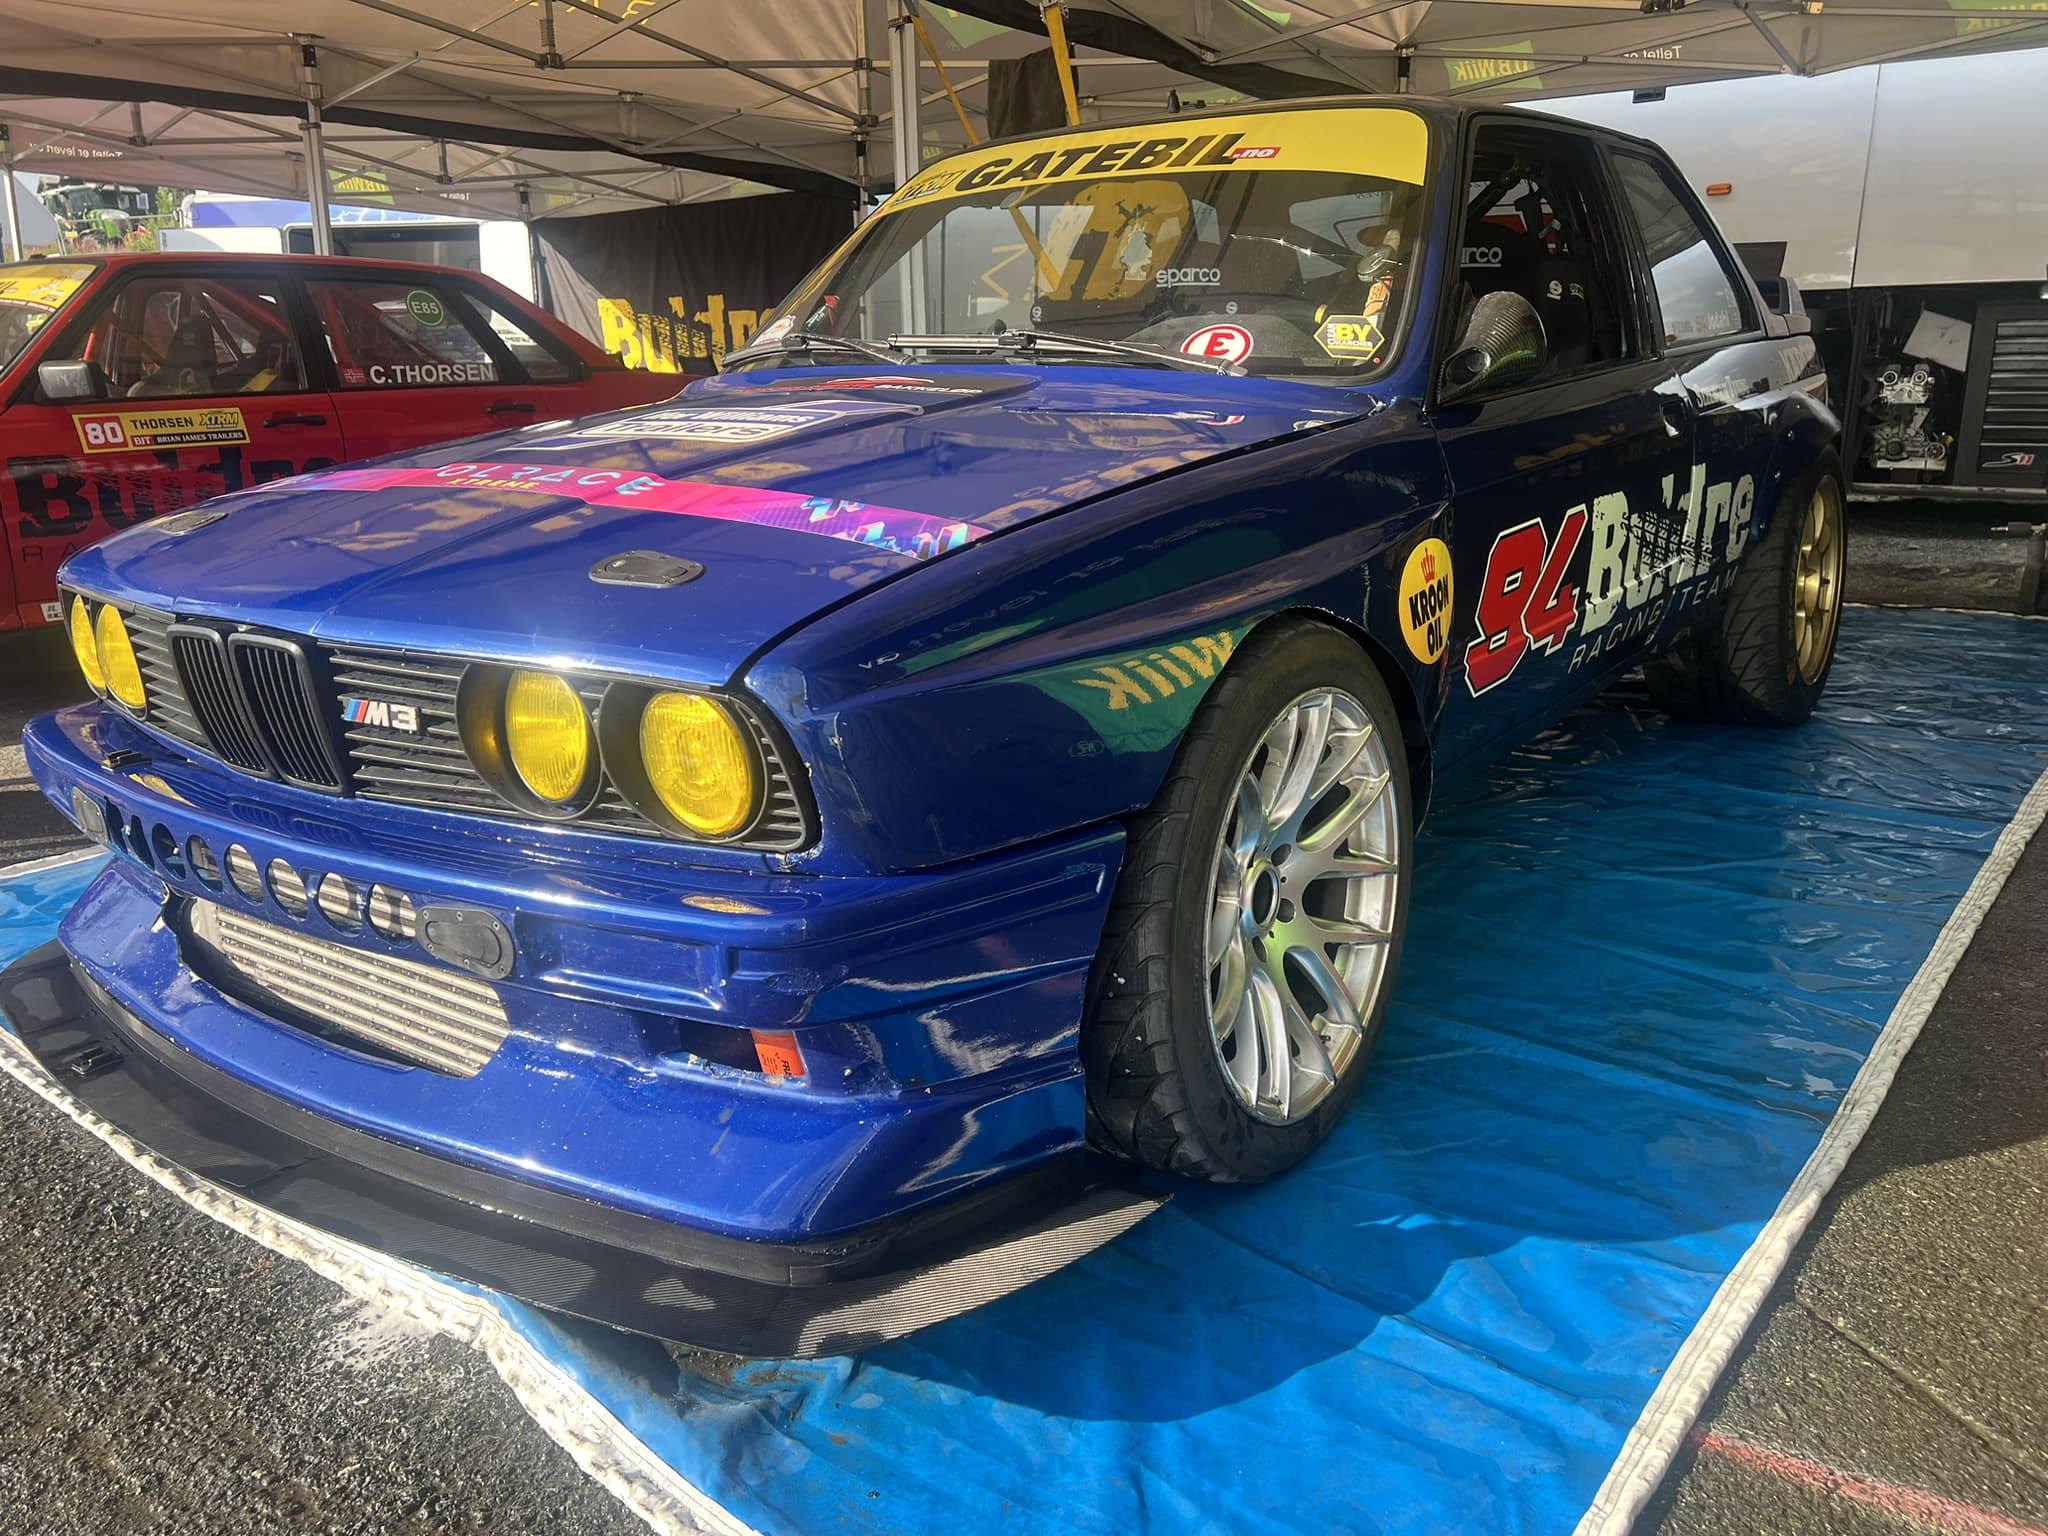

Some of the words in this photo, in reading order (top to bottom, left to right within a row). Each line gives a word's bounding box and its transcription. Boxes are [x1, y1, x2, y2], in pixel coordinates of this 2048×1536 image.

[1156, 266, 1221, 288] sparco
[411, 302, 440, 315] E85
[1203, 332, 1235, 357] E
[370, 364, 493, 384] C.THORSEN
[84, 421, 124, 445] 80
[130, 416, 194, 430] THORSEN
[156, 434, 181, 444] BRIAN
[182, 431, 207, 442] JAMES
[207, 430, 244, 441] TRAILERS
[447, 478, 540, 490] XTREME
[1409, 573, 1449, 630] KROON
[1464, 504, 1588, 698] 94
[1568, 599, 1665, 674] RACING
[1679, 567, 1738, 611] TEAM
[1427, 616, 1443, 657] OIL
[364, 700, 419, 731] M3
